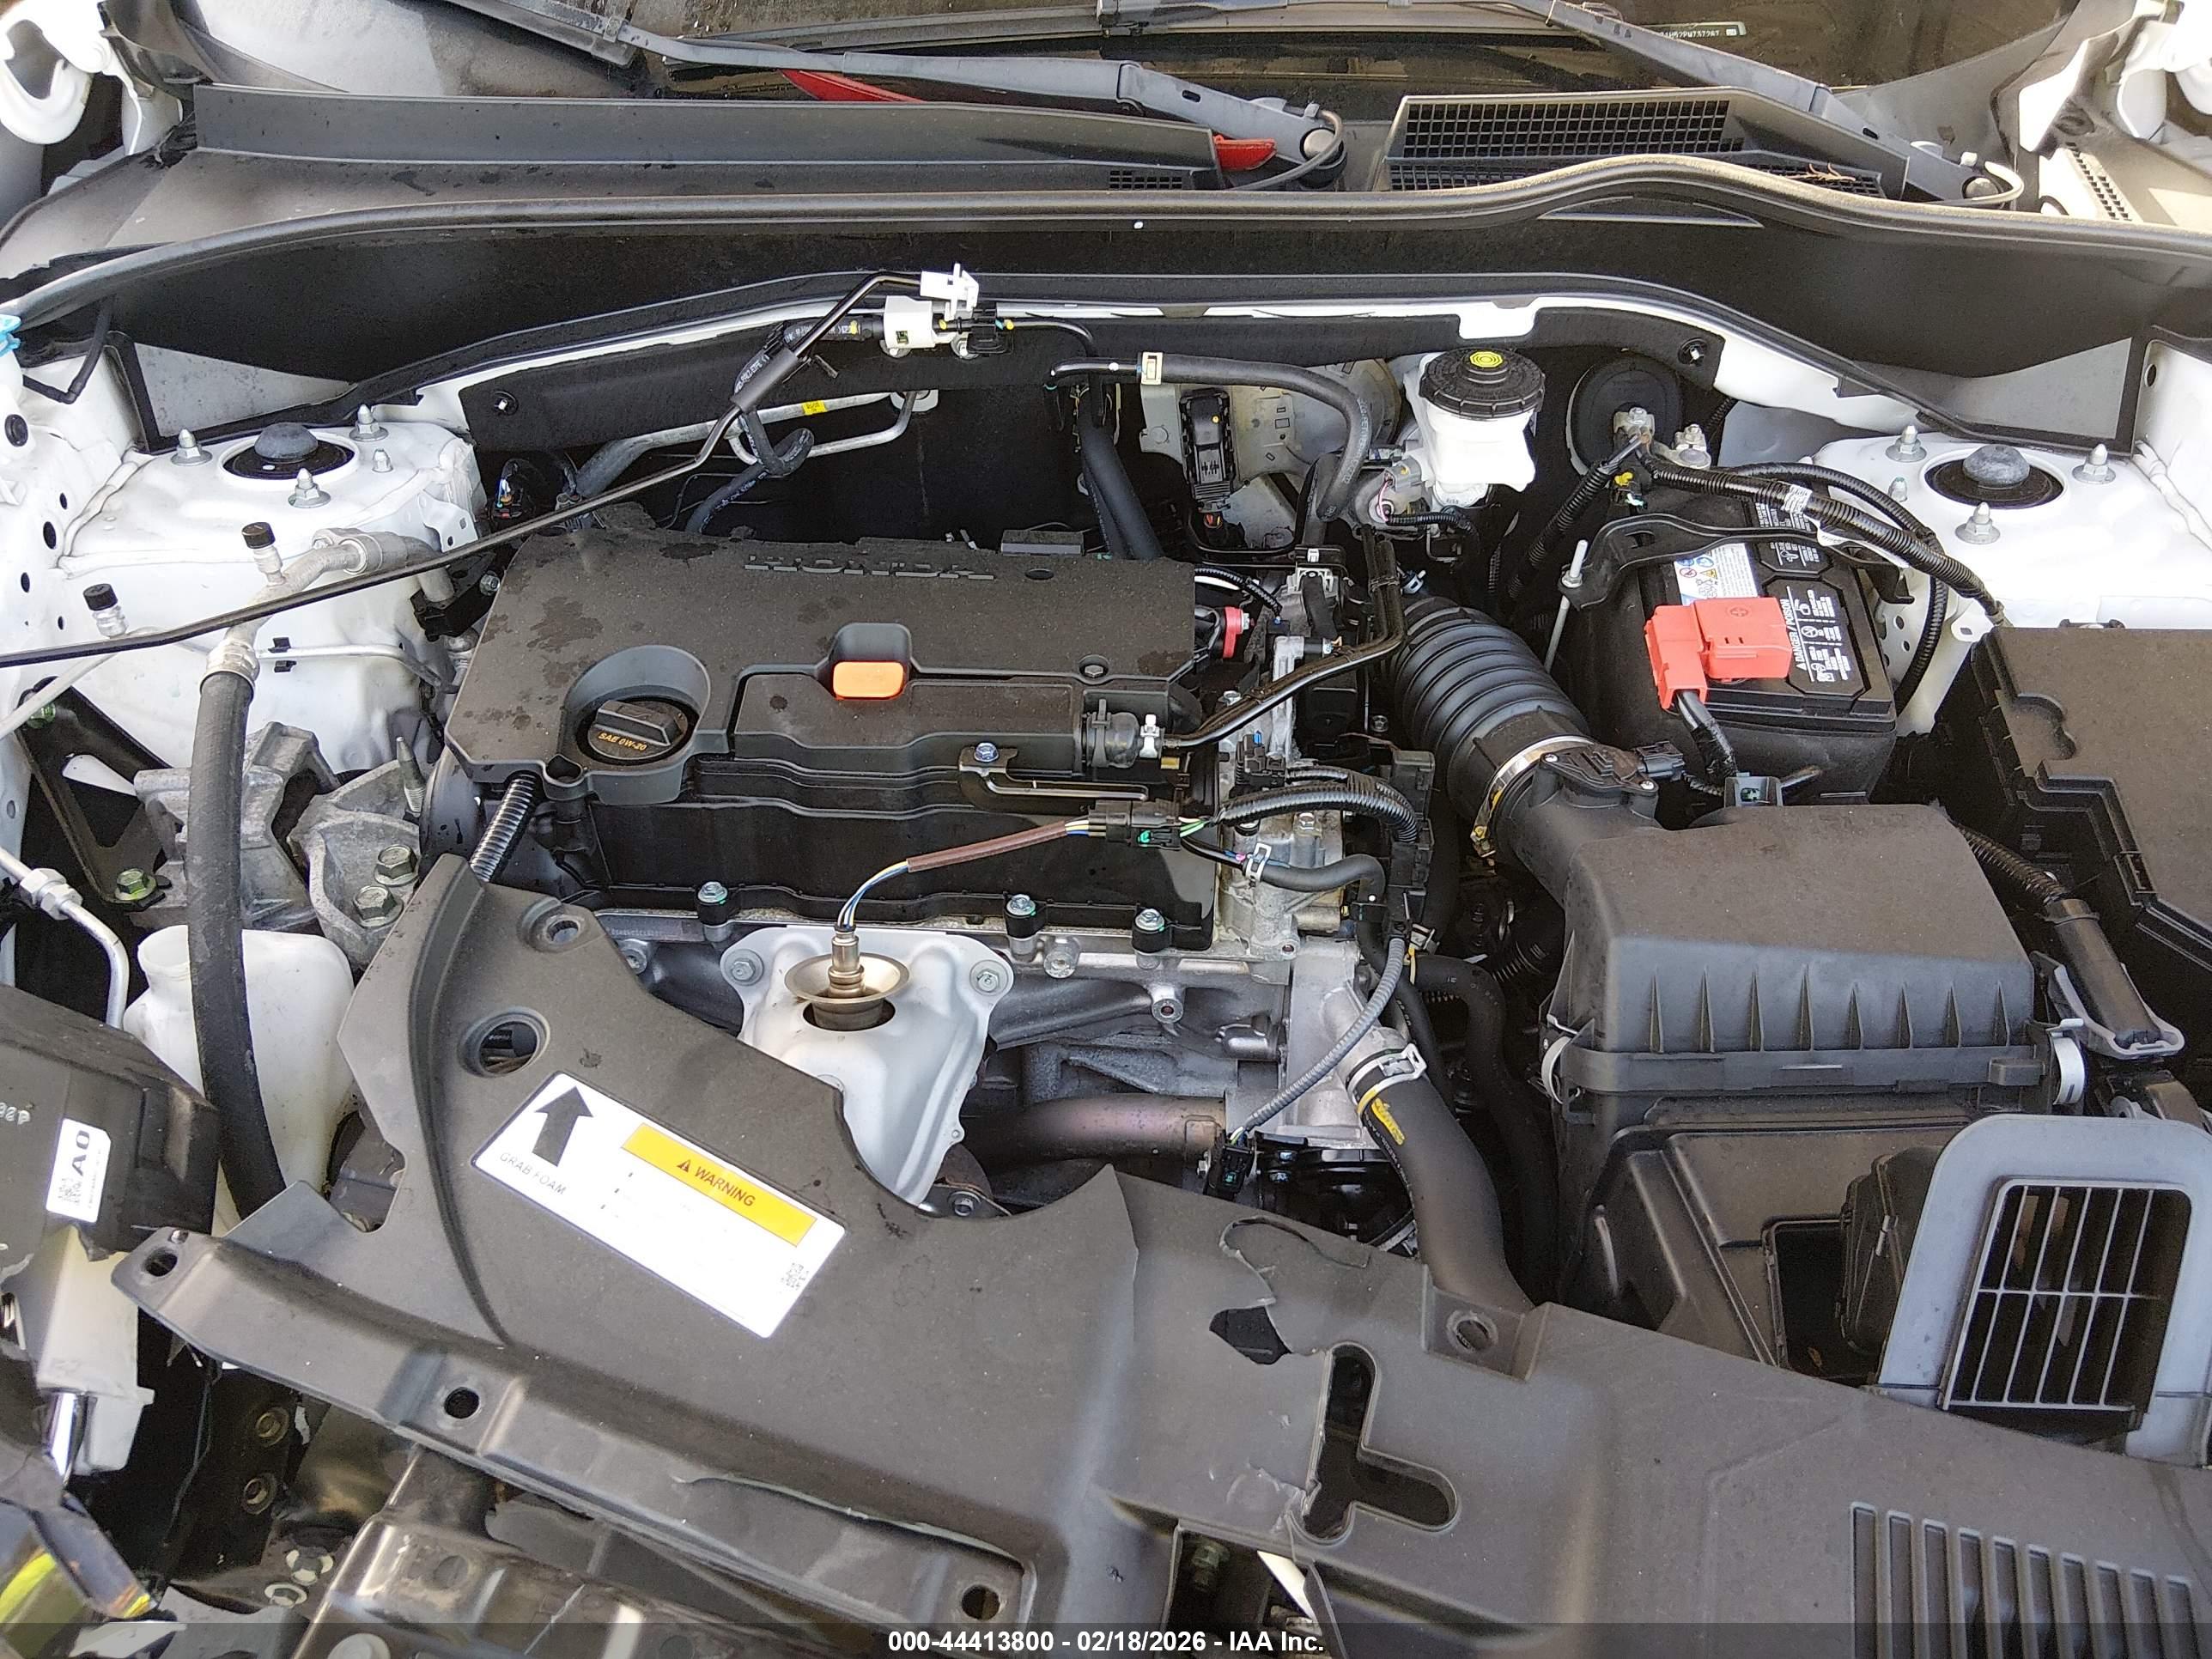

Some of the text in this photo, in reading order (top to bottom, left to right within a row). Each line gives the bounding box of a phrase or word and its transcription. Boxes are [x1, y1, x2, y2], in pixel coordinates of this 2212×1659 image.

[1780, 599, 1796, 625] POISON
[1789, 631, 1805, 662] DANGER
[598, 732, 647, 751] SAE 0W-20
[499, 1152, 567, 1195] GRAB FOAM
[696, 1165, 757, 1208] WARNING
